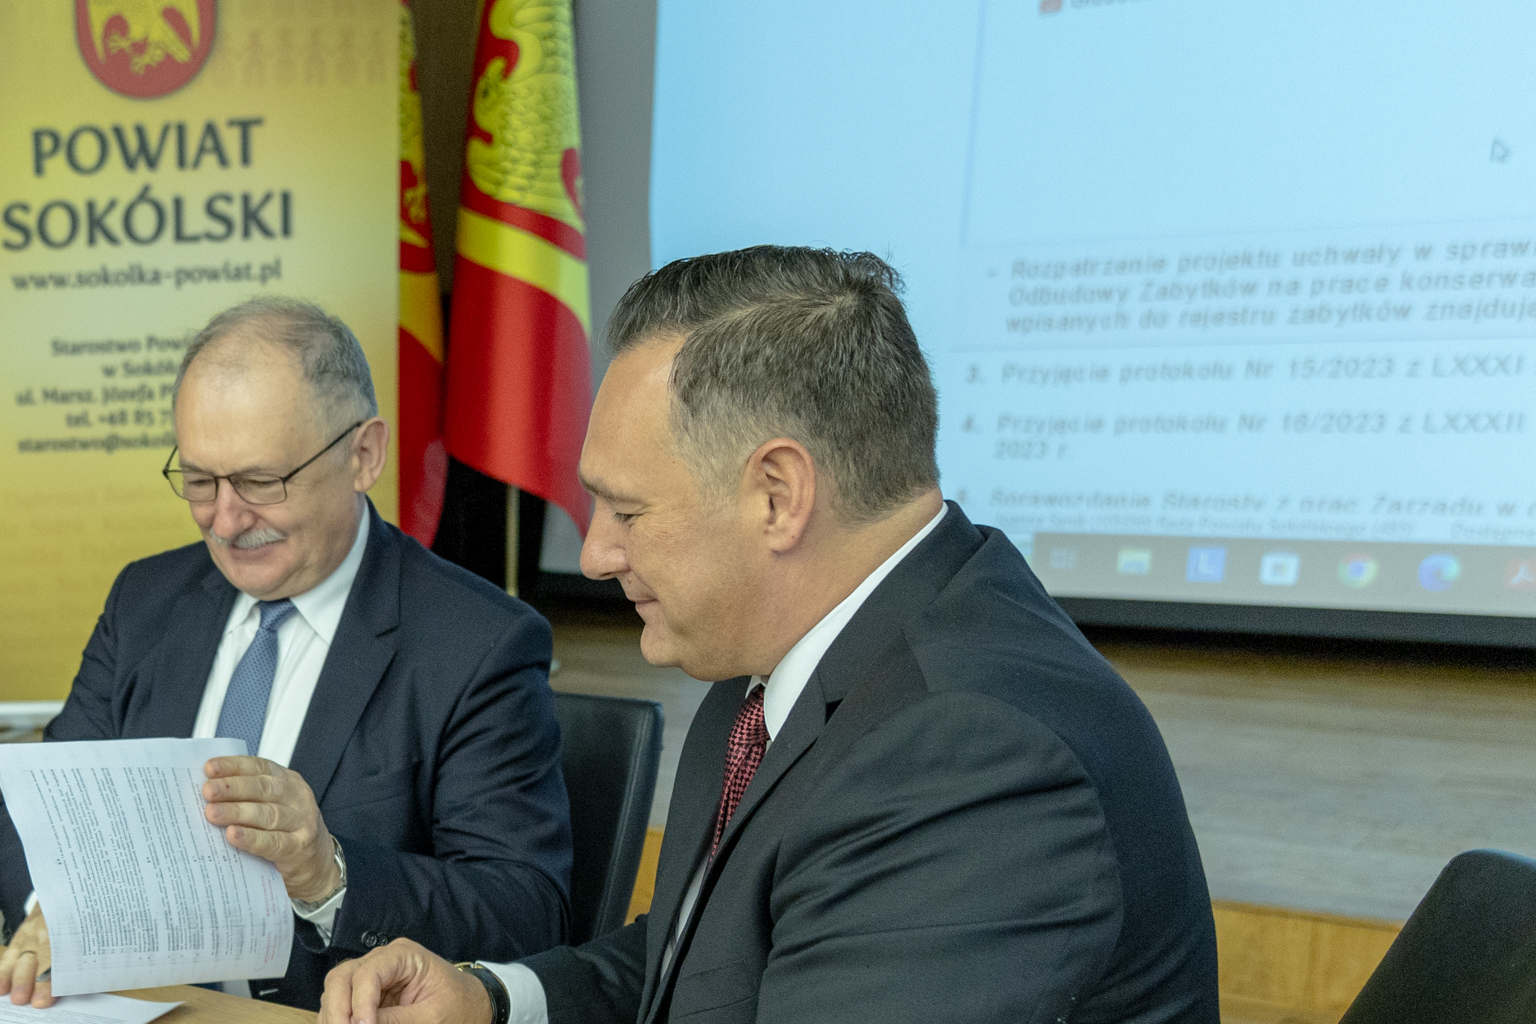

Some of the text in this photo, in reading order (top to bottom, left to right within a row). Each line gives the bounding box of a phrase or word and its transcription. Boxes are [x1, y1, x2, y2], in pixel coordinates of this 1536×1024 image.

[31, 117, 264, 177] POWIAT
[1, 185, 294, 251] SOKÓLSKI
[1176, 247, 1281, 275] projektu
[1415, 245, 1434, 262] w
[1267, 278, 1301, 297] na
[1309, 275, 1390, 298] prace
[1244, 358, 1276, 380] Nr
[1290, 356, 1395, 380] 15/2023
[1238, 412, 1268, 434] Nr
